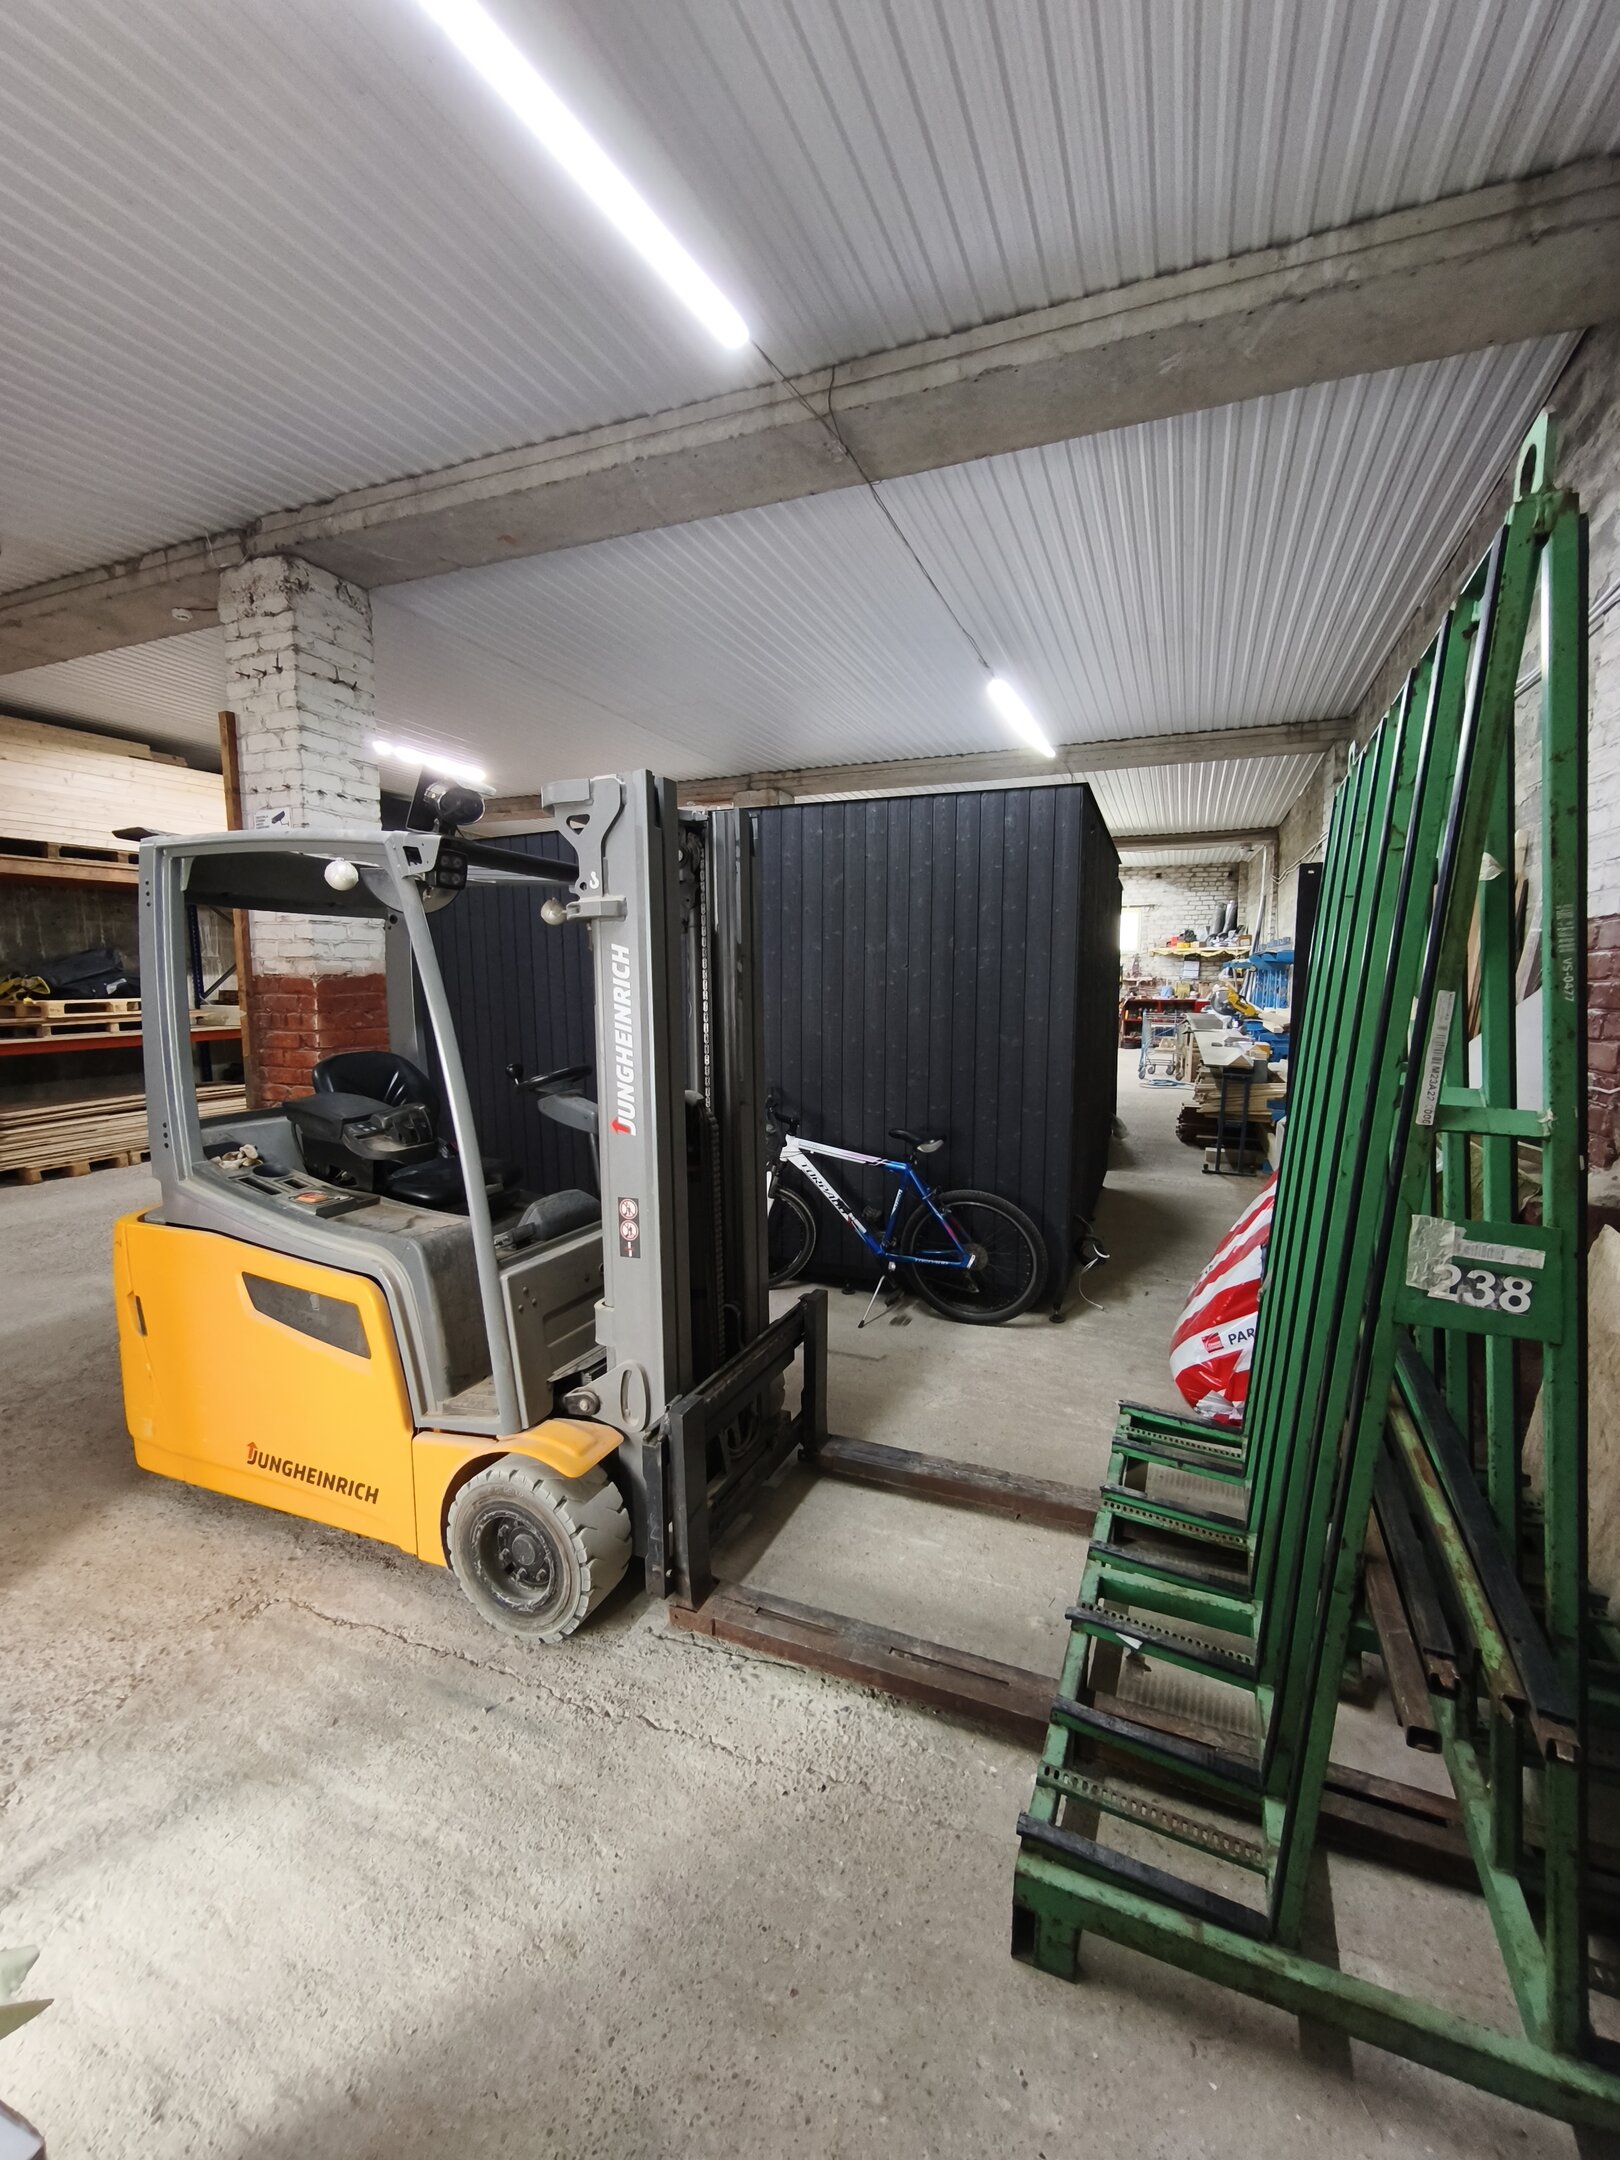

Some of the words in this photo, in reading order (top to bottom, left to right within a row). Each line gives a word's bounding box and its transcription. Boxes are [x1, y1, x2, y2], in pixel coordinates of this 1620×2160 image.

[1562, 957, 1575, 1002] VS-0477
[611, 943, 636, 1136] JUNGHEINRICH
[1427, 1263, 1533, 1313] 238
[246, 1448, 380, 1505] JUNGHEINRICH
